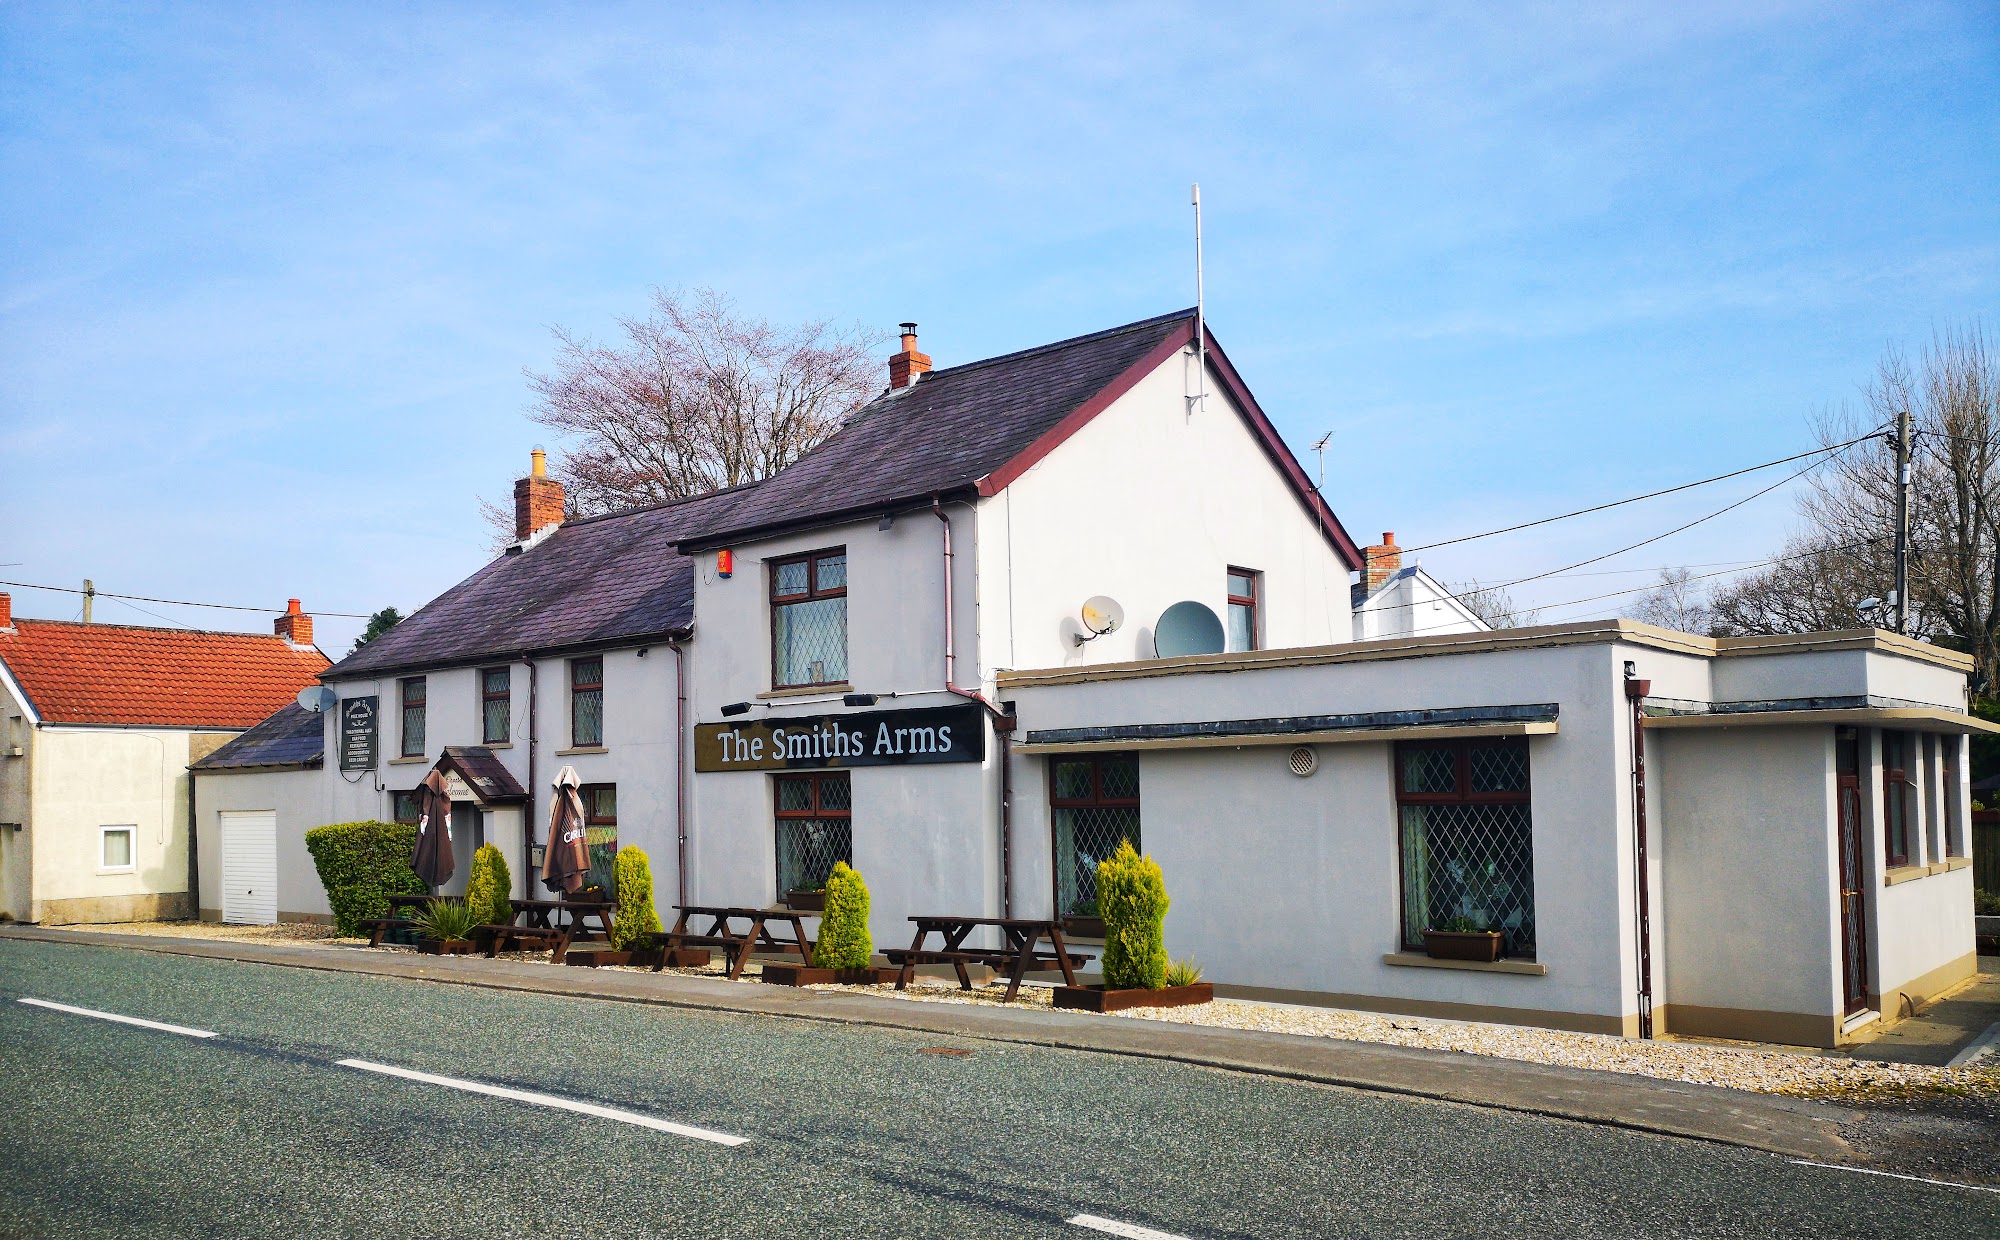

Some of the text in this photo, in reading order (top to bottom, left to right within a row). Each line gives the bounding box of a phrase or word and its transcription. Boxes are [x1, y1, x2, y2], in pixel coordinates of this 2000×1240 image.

[717, 721, 952, 762] The Smiths Arms
